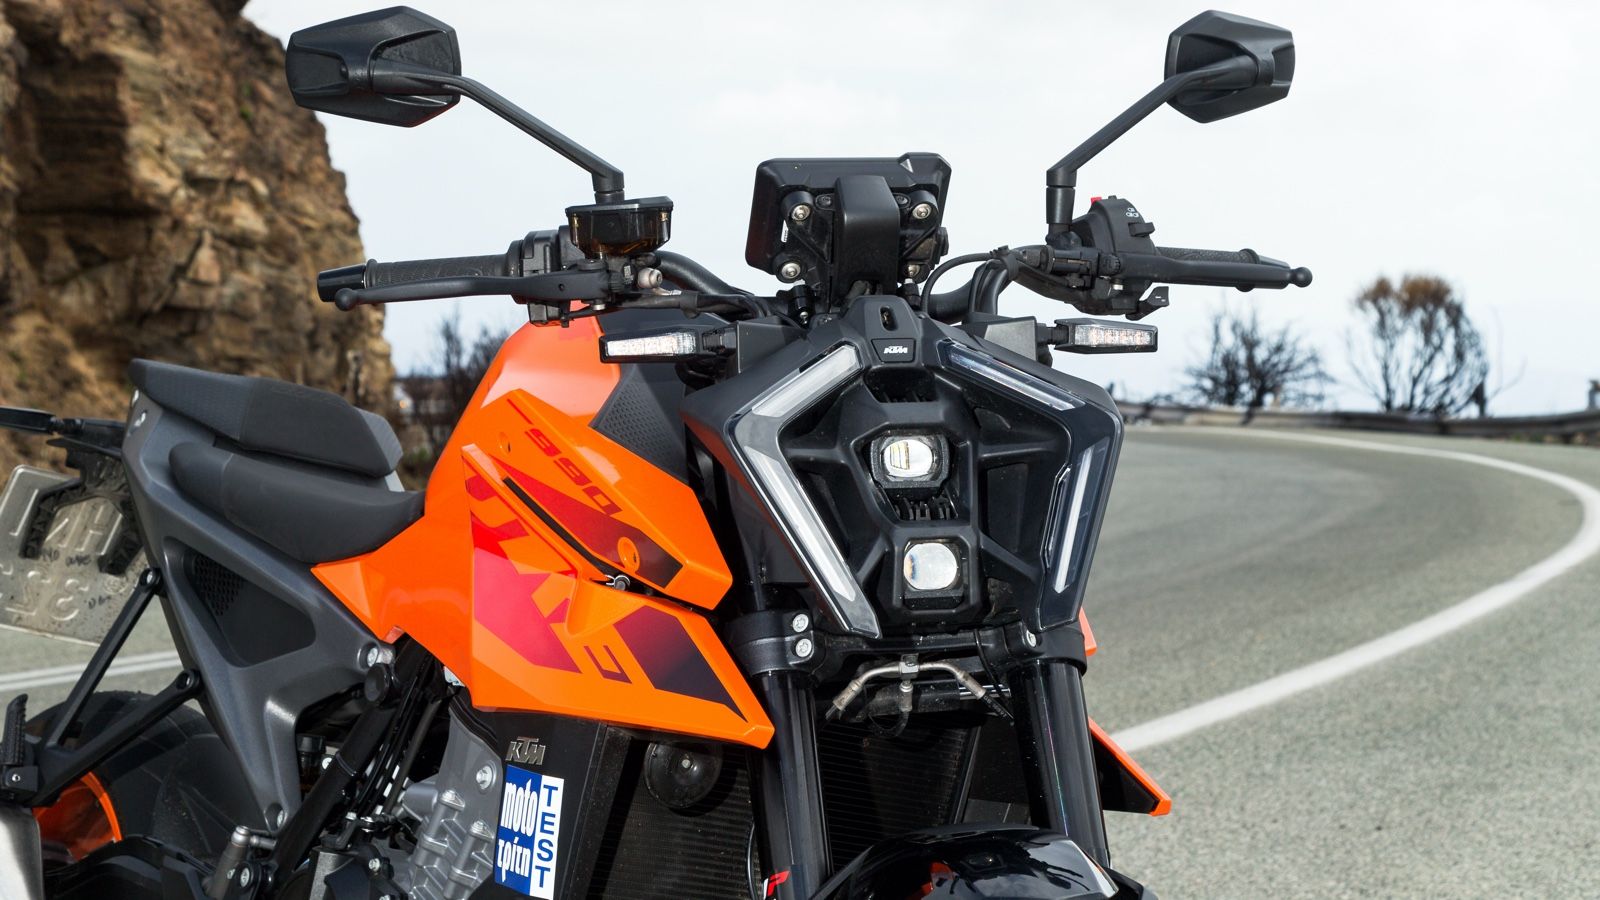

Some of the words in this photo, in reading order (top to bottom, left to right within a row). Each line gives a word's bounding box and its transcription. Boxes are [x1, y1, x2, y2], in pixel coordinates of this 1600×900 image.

[883, 345, 908, 354] KTM
[525, 428, 623, 516] 990
[505, 736, 546, 766] KTM
[500, 778, 538, 837] moto
[534, 785, 559, 888] TEST
